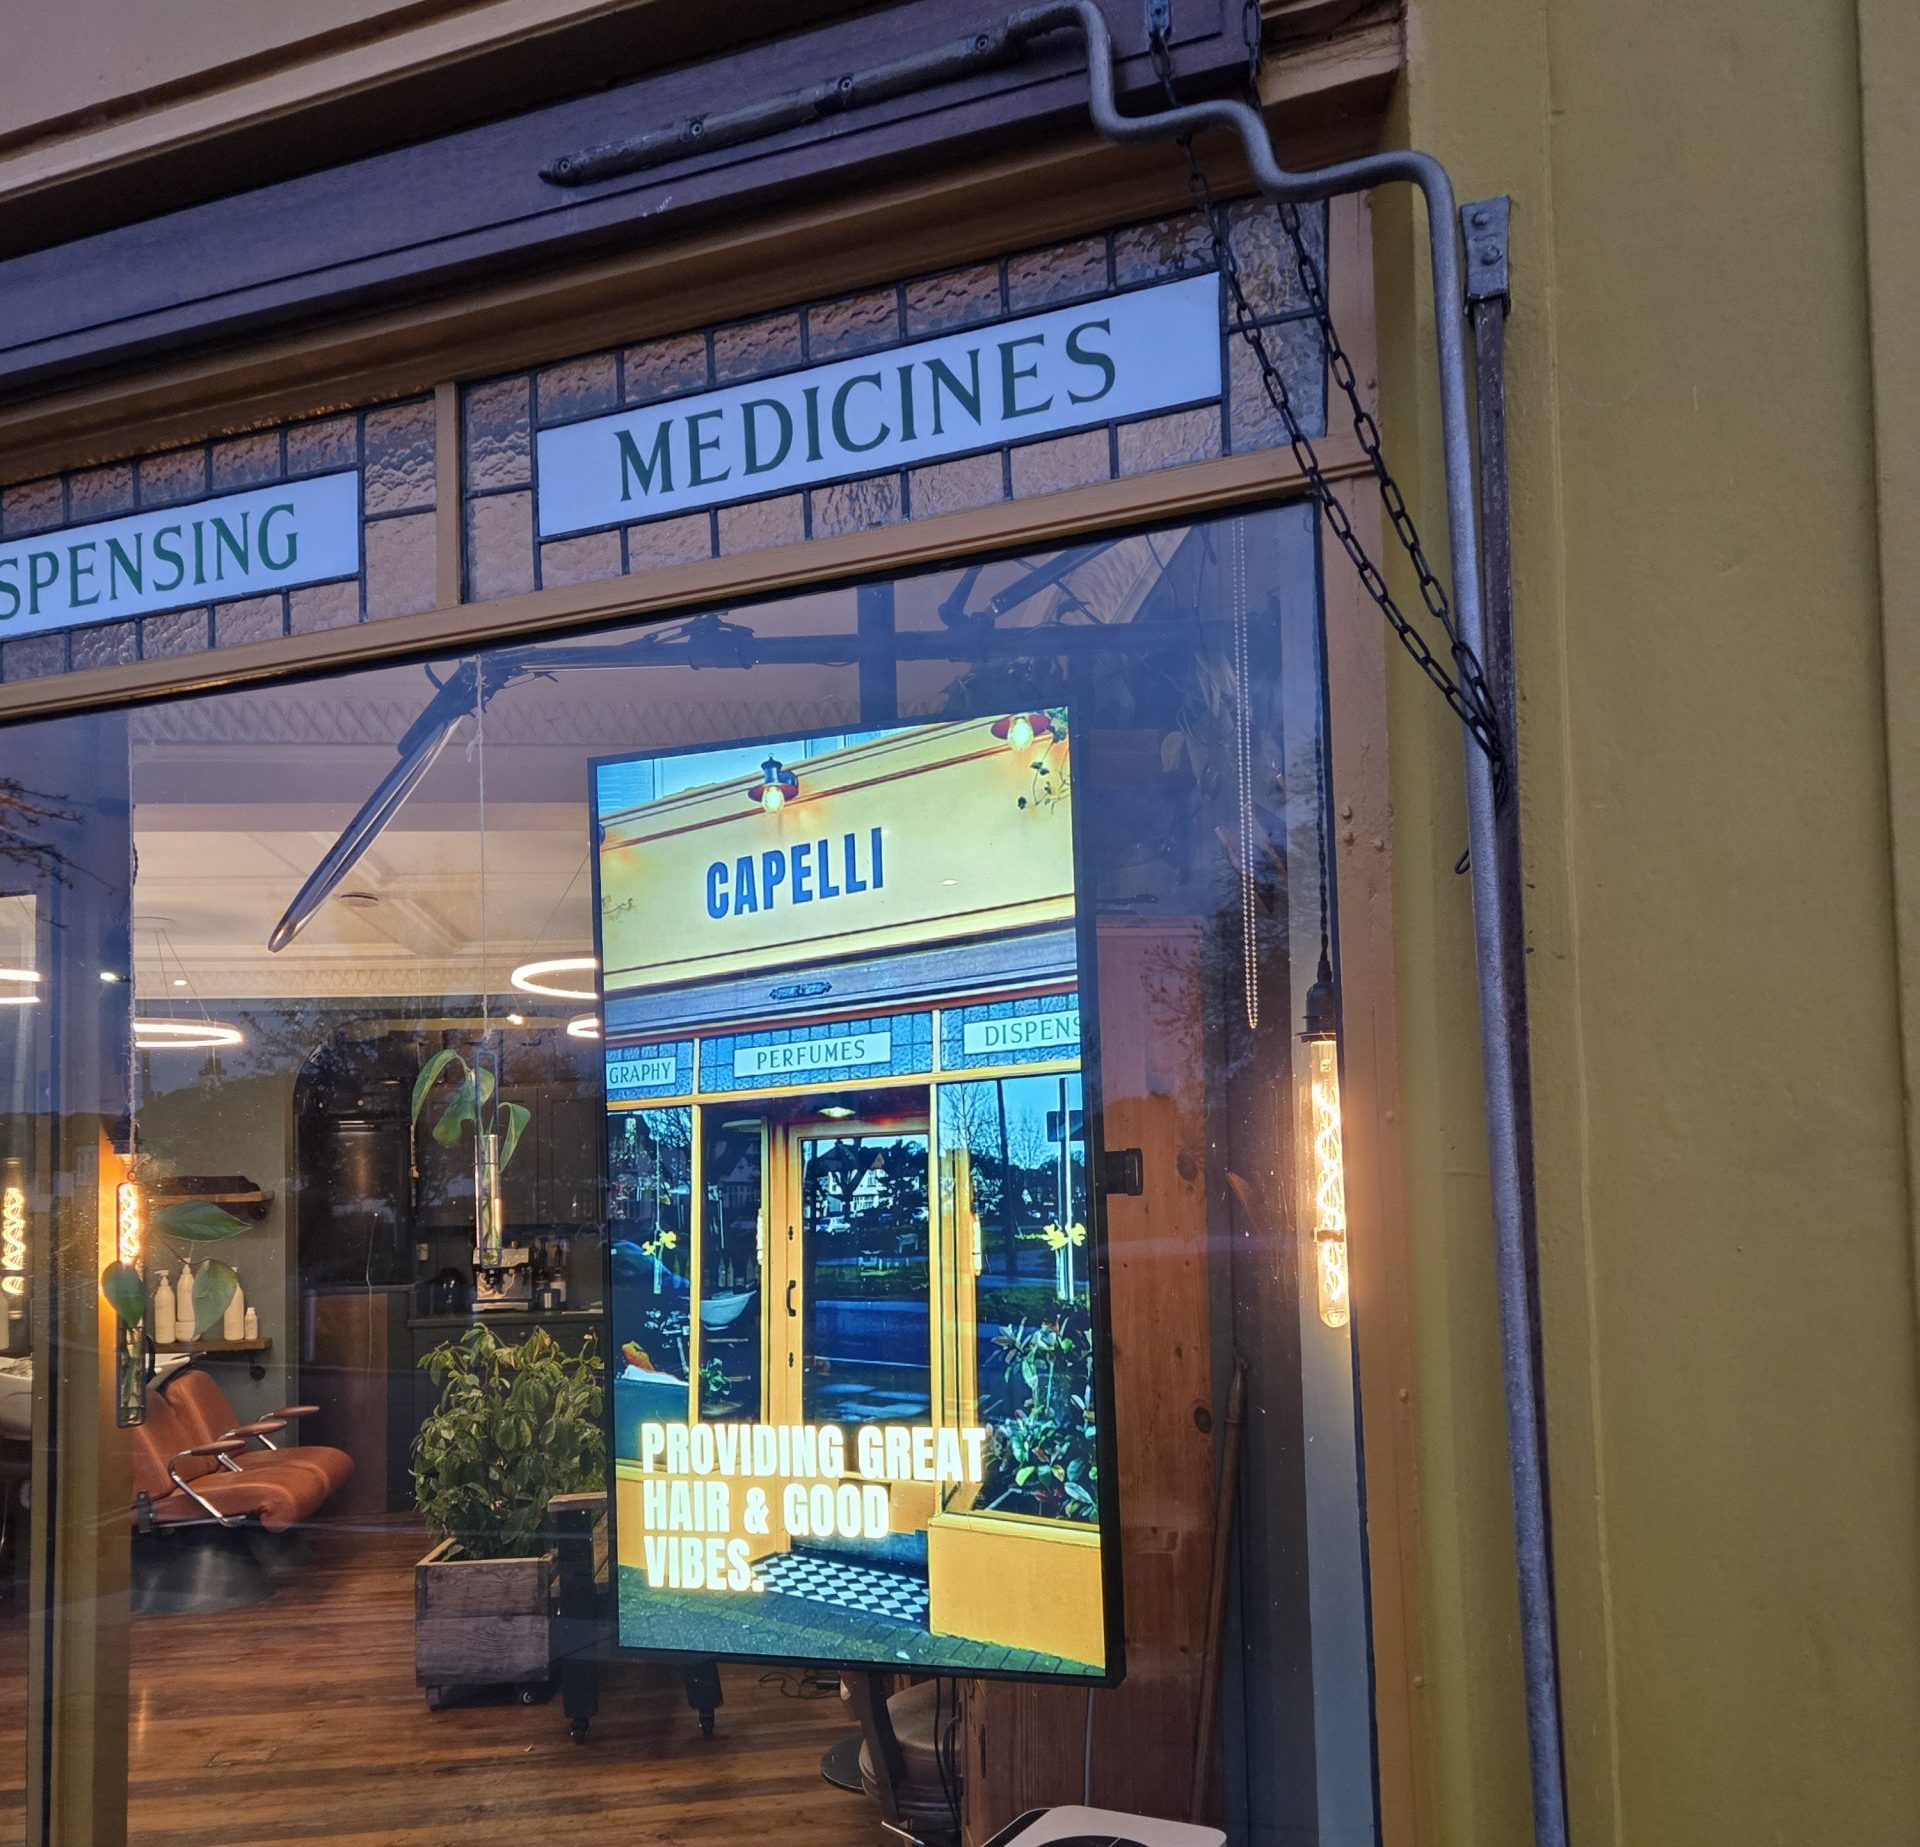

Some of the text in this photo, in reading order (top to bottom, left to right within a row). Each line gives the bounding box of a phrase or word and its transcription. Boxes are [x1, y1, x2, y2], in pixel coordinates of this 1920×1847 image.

[614, 318, 1116, 500] MEDICINES
[0, 503, 298, 620] SPENSING
[706, 827, 884, 919] CAPELLI
[609, 1062, 671, 1085] GRAPHY
[756, 1039, 866, 1070] PERFUMES
[642, 1423, 985, 1482] PROVIDING GREAT
[643, 1480, 889, 1538] HAIR & GOOD
[644, 1536, 764, 1592] VIBES.
